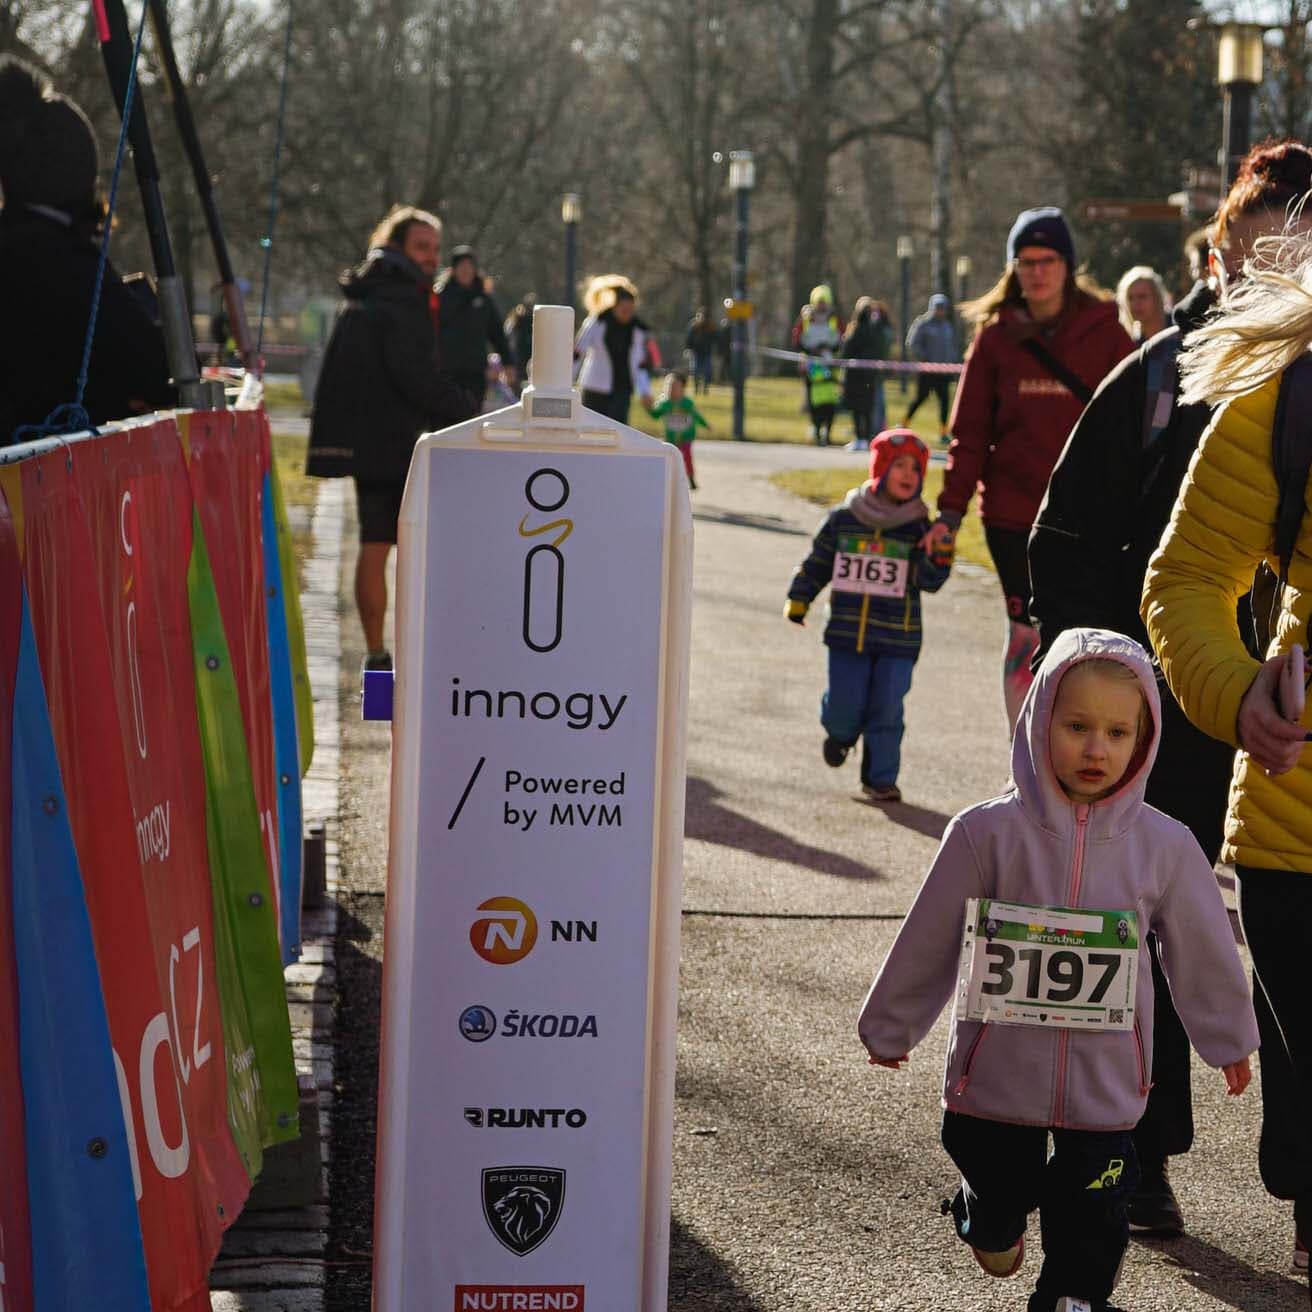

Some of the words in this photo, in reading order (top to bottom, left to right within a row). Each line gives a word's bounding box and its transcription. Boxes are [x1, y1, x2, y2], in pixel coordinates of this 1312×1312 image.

[837, 556, 898, 584] 3163
[450, 677, 628, 730] innogy
[504, 770, 626, 796] Powered
[504, 802, 538, 832] by
[549, 803, 623, 828] MVM
[550, 920, 598, 942] NN
[980, 942, 1122, 1004] 3197
[501, 1009, 599, 1039] ŠKODA
[487, 1107, 587, 1129] RUNTO
[489, 1173, 558, 1184] PEUGEOT
[462, 1292, 579, 1311] NUTREND
